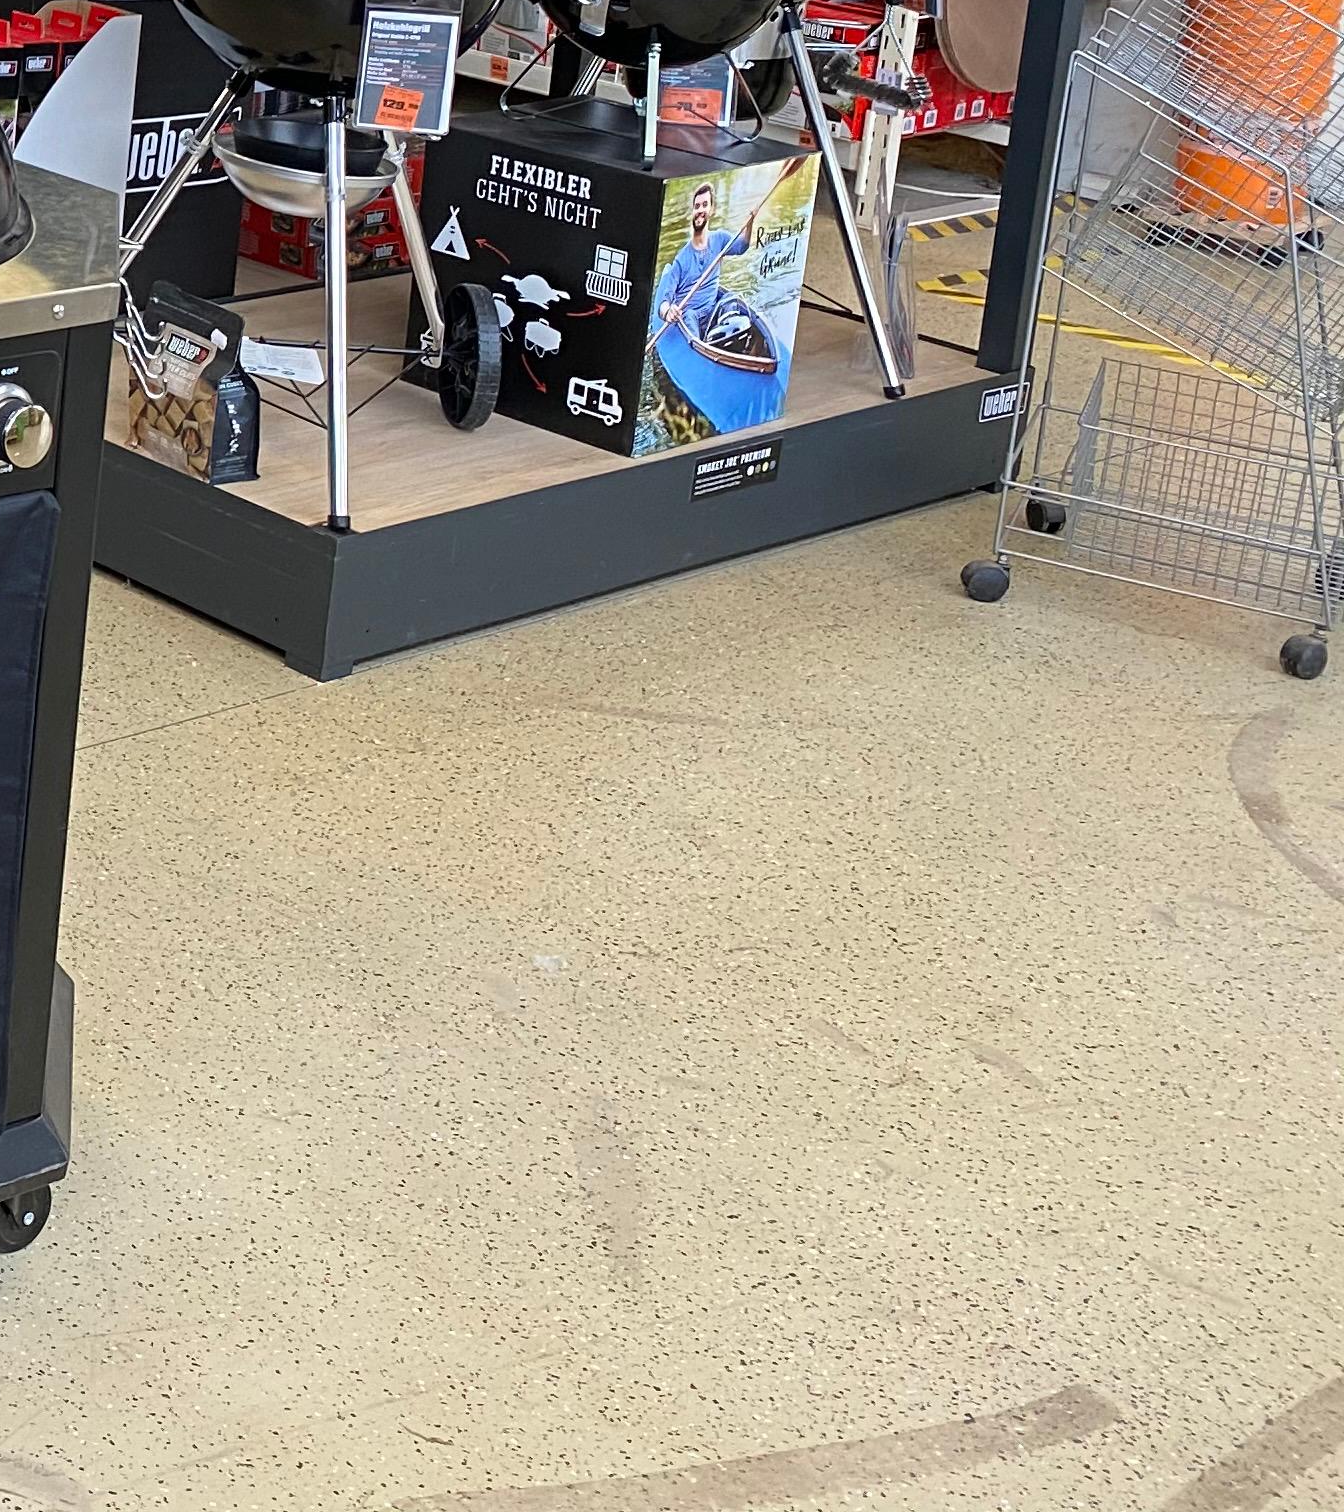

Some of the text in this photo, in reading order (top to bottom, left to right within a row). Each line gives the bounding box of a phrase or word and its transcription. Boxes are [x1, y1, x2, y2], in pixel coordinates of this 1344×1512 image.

[490, 154, 592, 200] FLEXIBLER
[476, 178, 602, 229] GEHT'S NICHT
